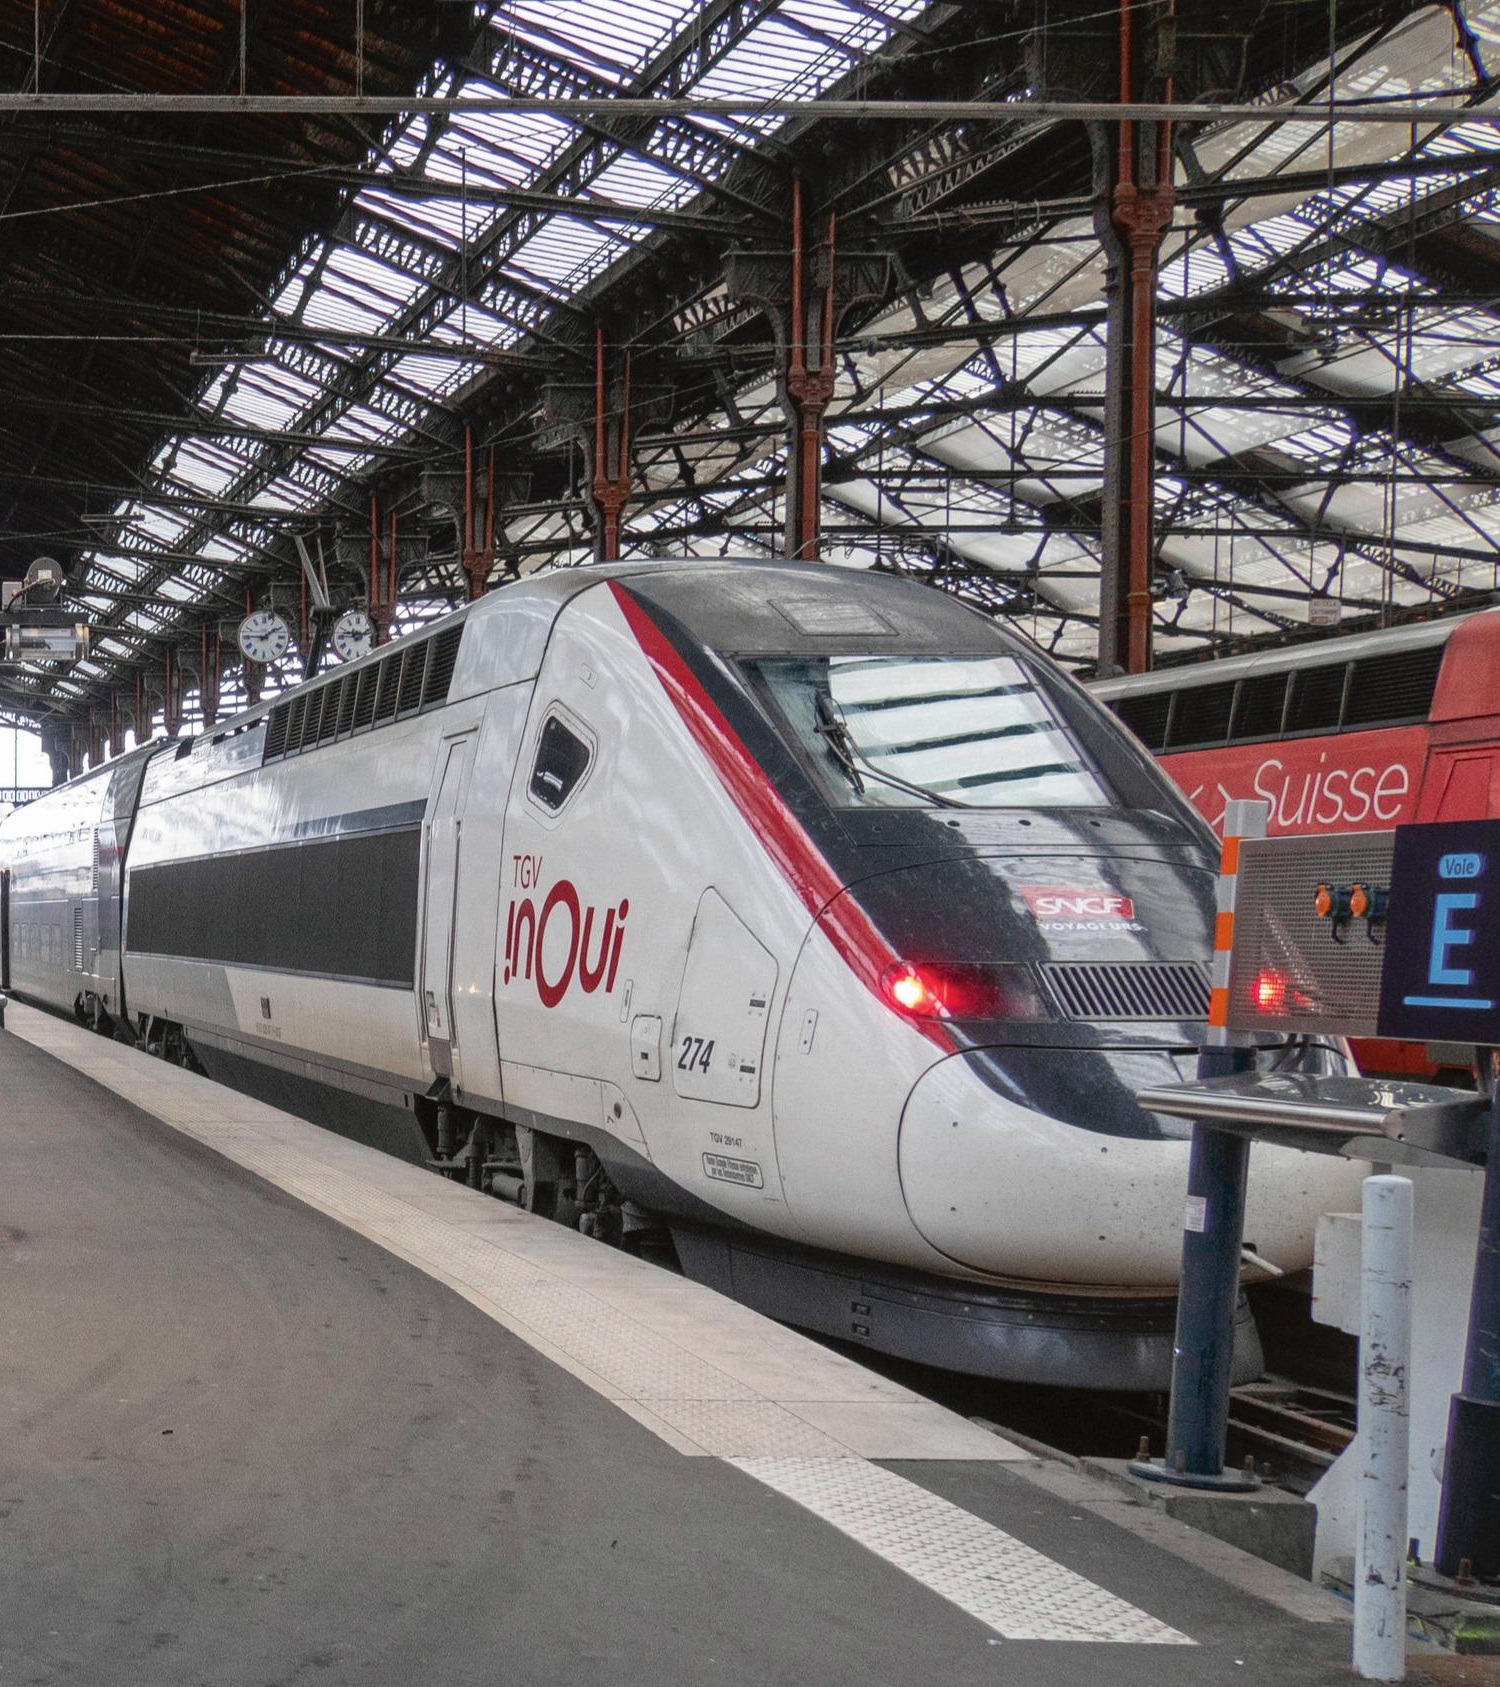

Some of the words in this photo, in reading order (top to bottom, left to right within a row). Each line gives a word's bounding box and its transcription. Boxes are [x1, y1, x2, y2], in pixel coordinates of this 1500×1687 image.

[1253, 752, 1409, 826] Suisse
[513, 854, 542, 889] TGV
[1445, 858, 1475, 875] Voie
[1036, 897, 1122, 914] SNCF
[1428, 893, 1476, 985] E
[677, 1036, 715, 1074] 274
[708, 1131, 723, 1144] TGV
